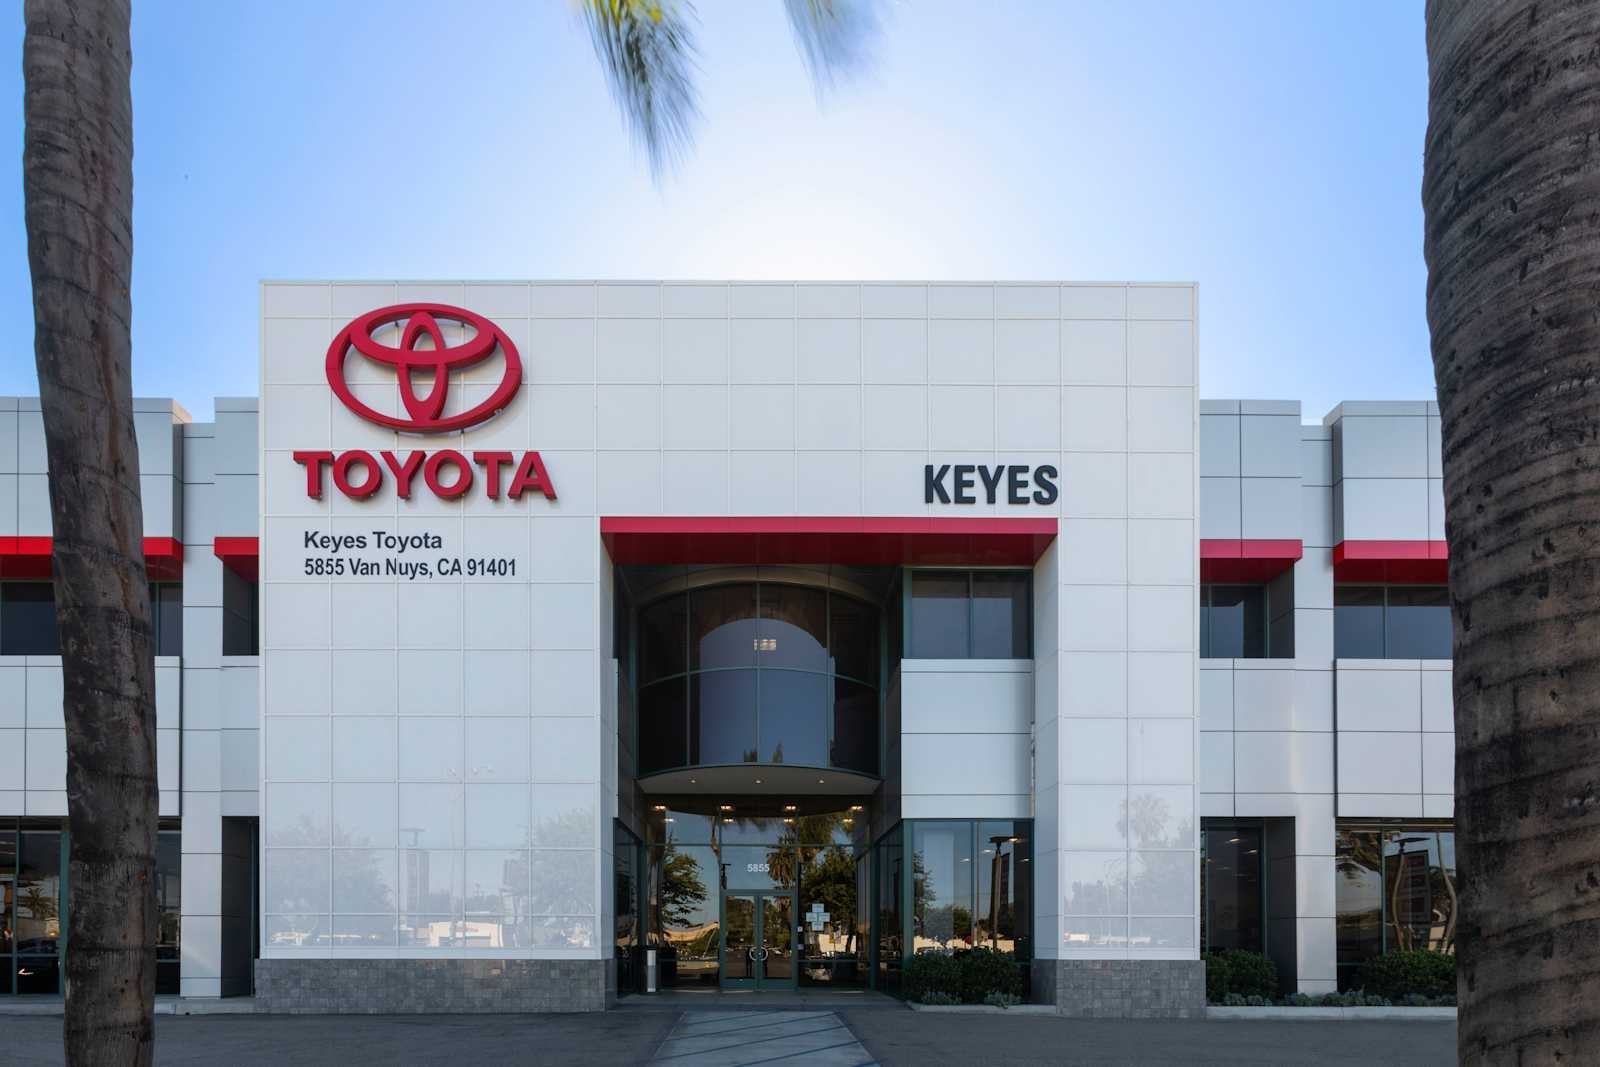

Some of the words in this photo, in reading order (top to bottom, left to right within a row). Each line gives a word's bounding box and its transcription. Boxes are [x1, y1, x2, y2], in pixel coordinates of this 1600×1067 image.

[293, 449, 557, 499] TOYOTA
[924, 464, 1059, 505] KEYES
[304, 530, 367, 553] Keyes
[373, 531, 442, 553] Toyota
[304, 558, 344, 576] 5855
[349, 558, 380, 576] Van
[385, 558, 433, 579] Nuys,
[437, 558, 462, 576] CA
[467, 558, 516, 576] 91401
[747, 863, 770, 873] 5855
